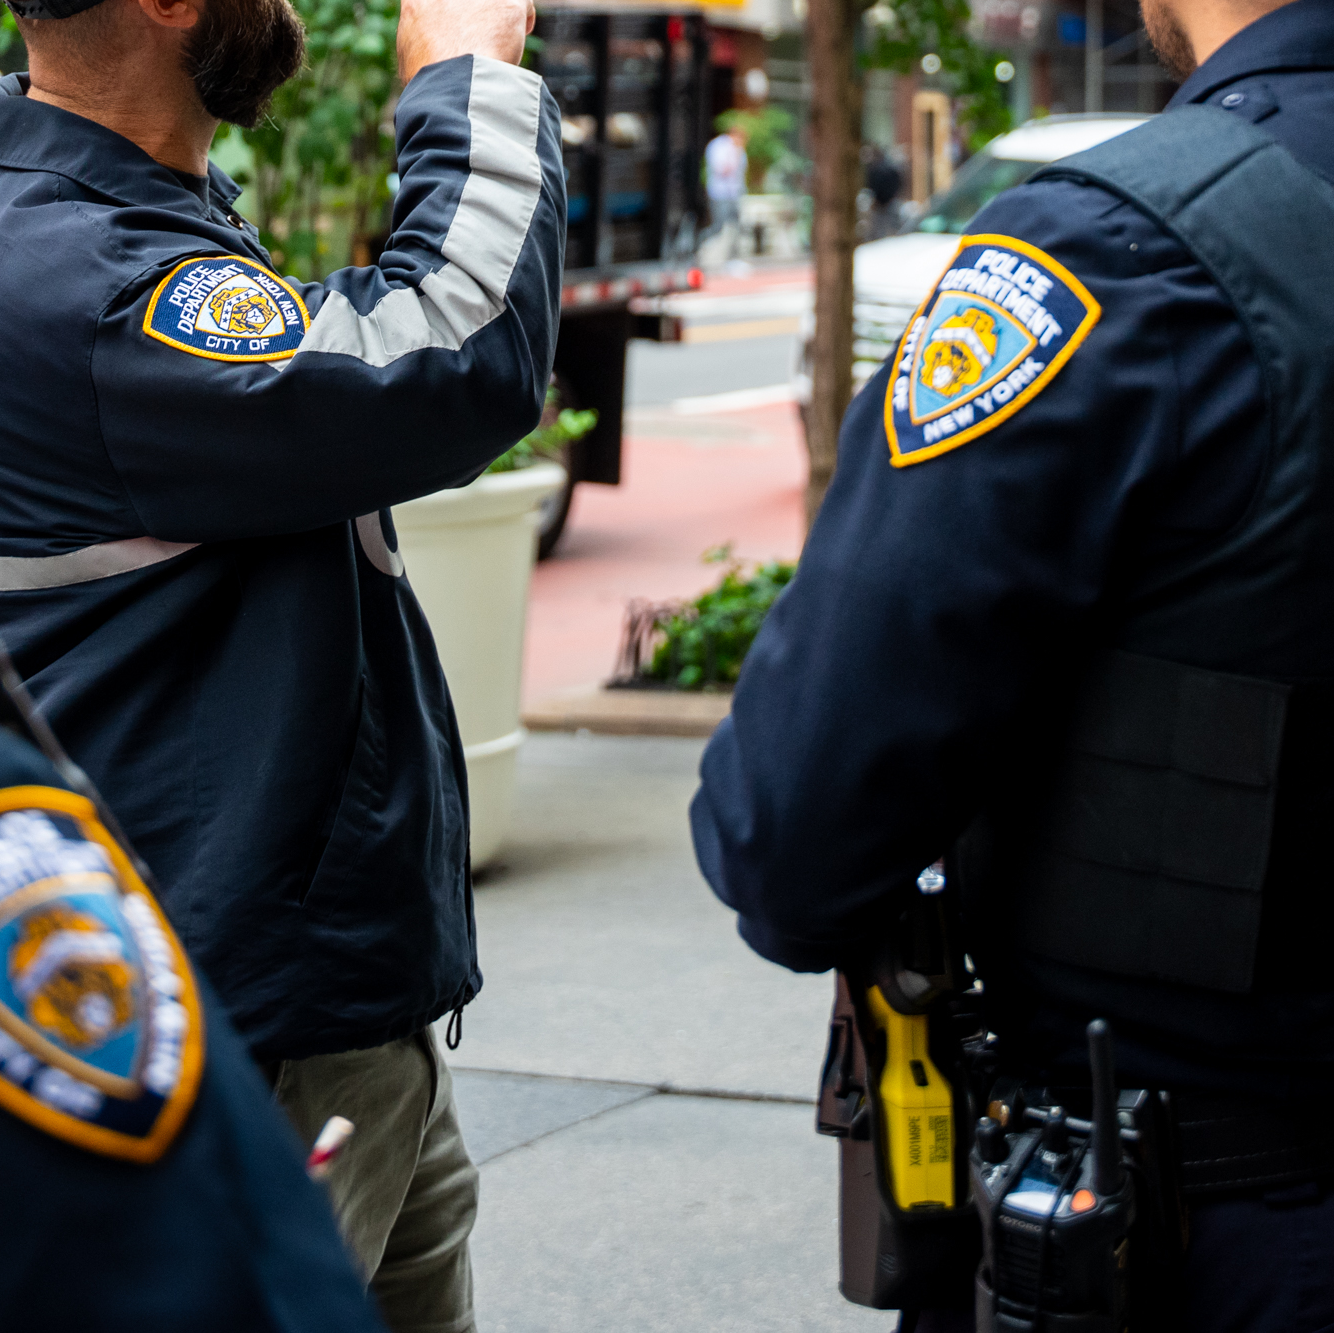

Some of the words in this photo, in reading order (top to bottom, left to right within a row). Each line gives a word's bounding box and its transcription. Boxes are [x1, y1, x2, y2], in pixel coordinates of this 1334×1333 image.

[168, 264, 215, 308] POLICE
[177, 263, 244, 335] DEPARTMENT
[253, 272, 285, 300] YORK
[973, 248, 1054, 302] POLICE
[278, 299, 300, 326] NEW
[937, 267, 1063, 347] DEPARTMENT
[205, 335, 242, 351] CITY
[249, 337, 270, 351] OF
[923, 403, 975, 444] NEW
[973, 356, 1046, 414] YORK
